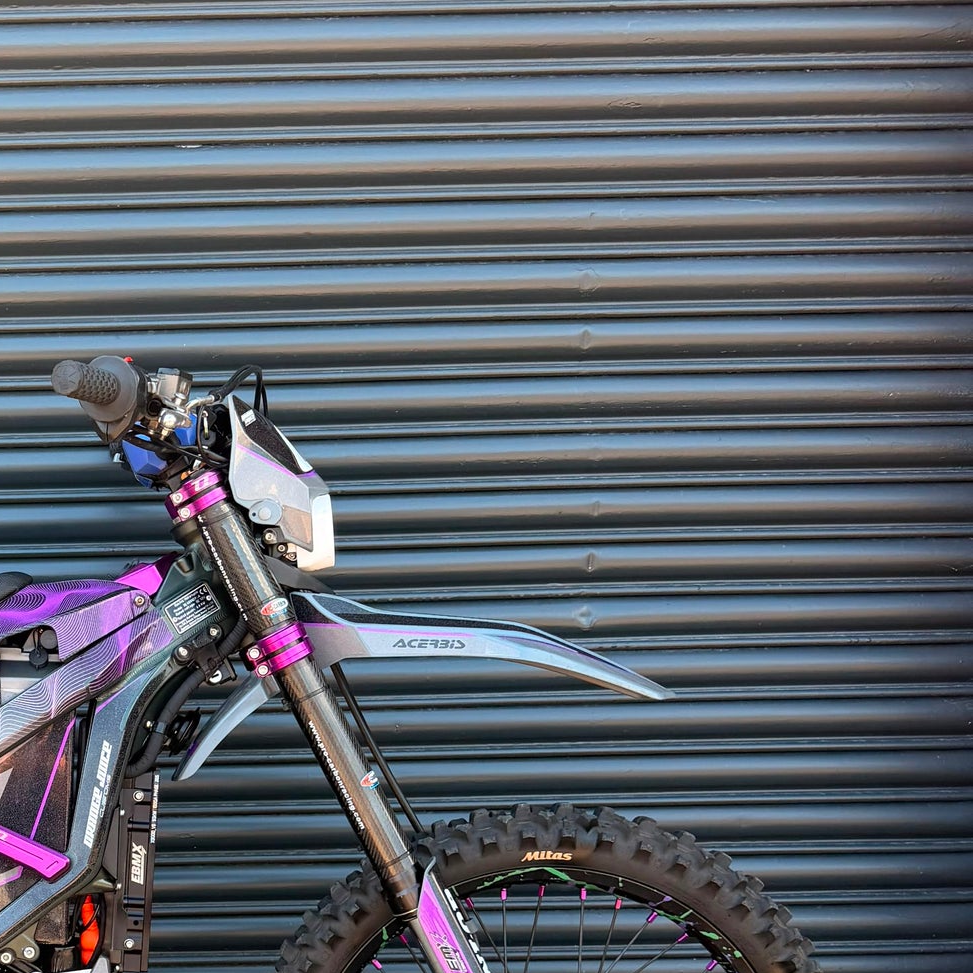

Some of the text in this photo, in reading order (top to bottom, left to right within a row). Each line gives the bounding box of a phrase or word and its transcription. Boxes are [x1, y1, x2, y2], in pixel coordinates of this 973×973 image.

[197, 514, 248, 622] w.pro-carbonracing.cm
[308, 720, 365, 830] www.pro-carbonracing.com
[130, 842, 147, 885] EBMX
[520, 850, 573, 862] Mitas
